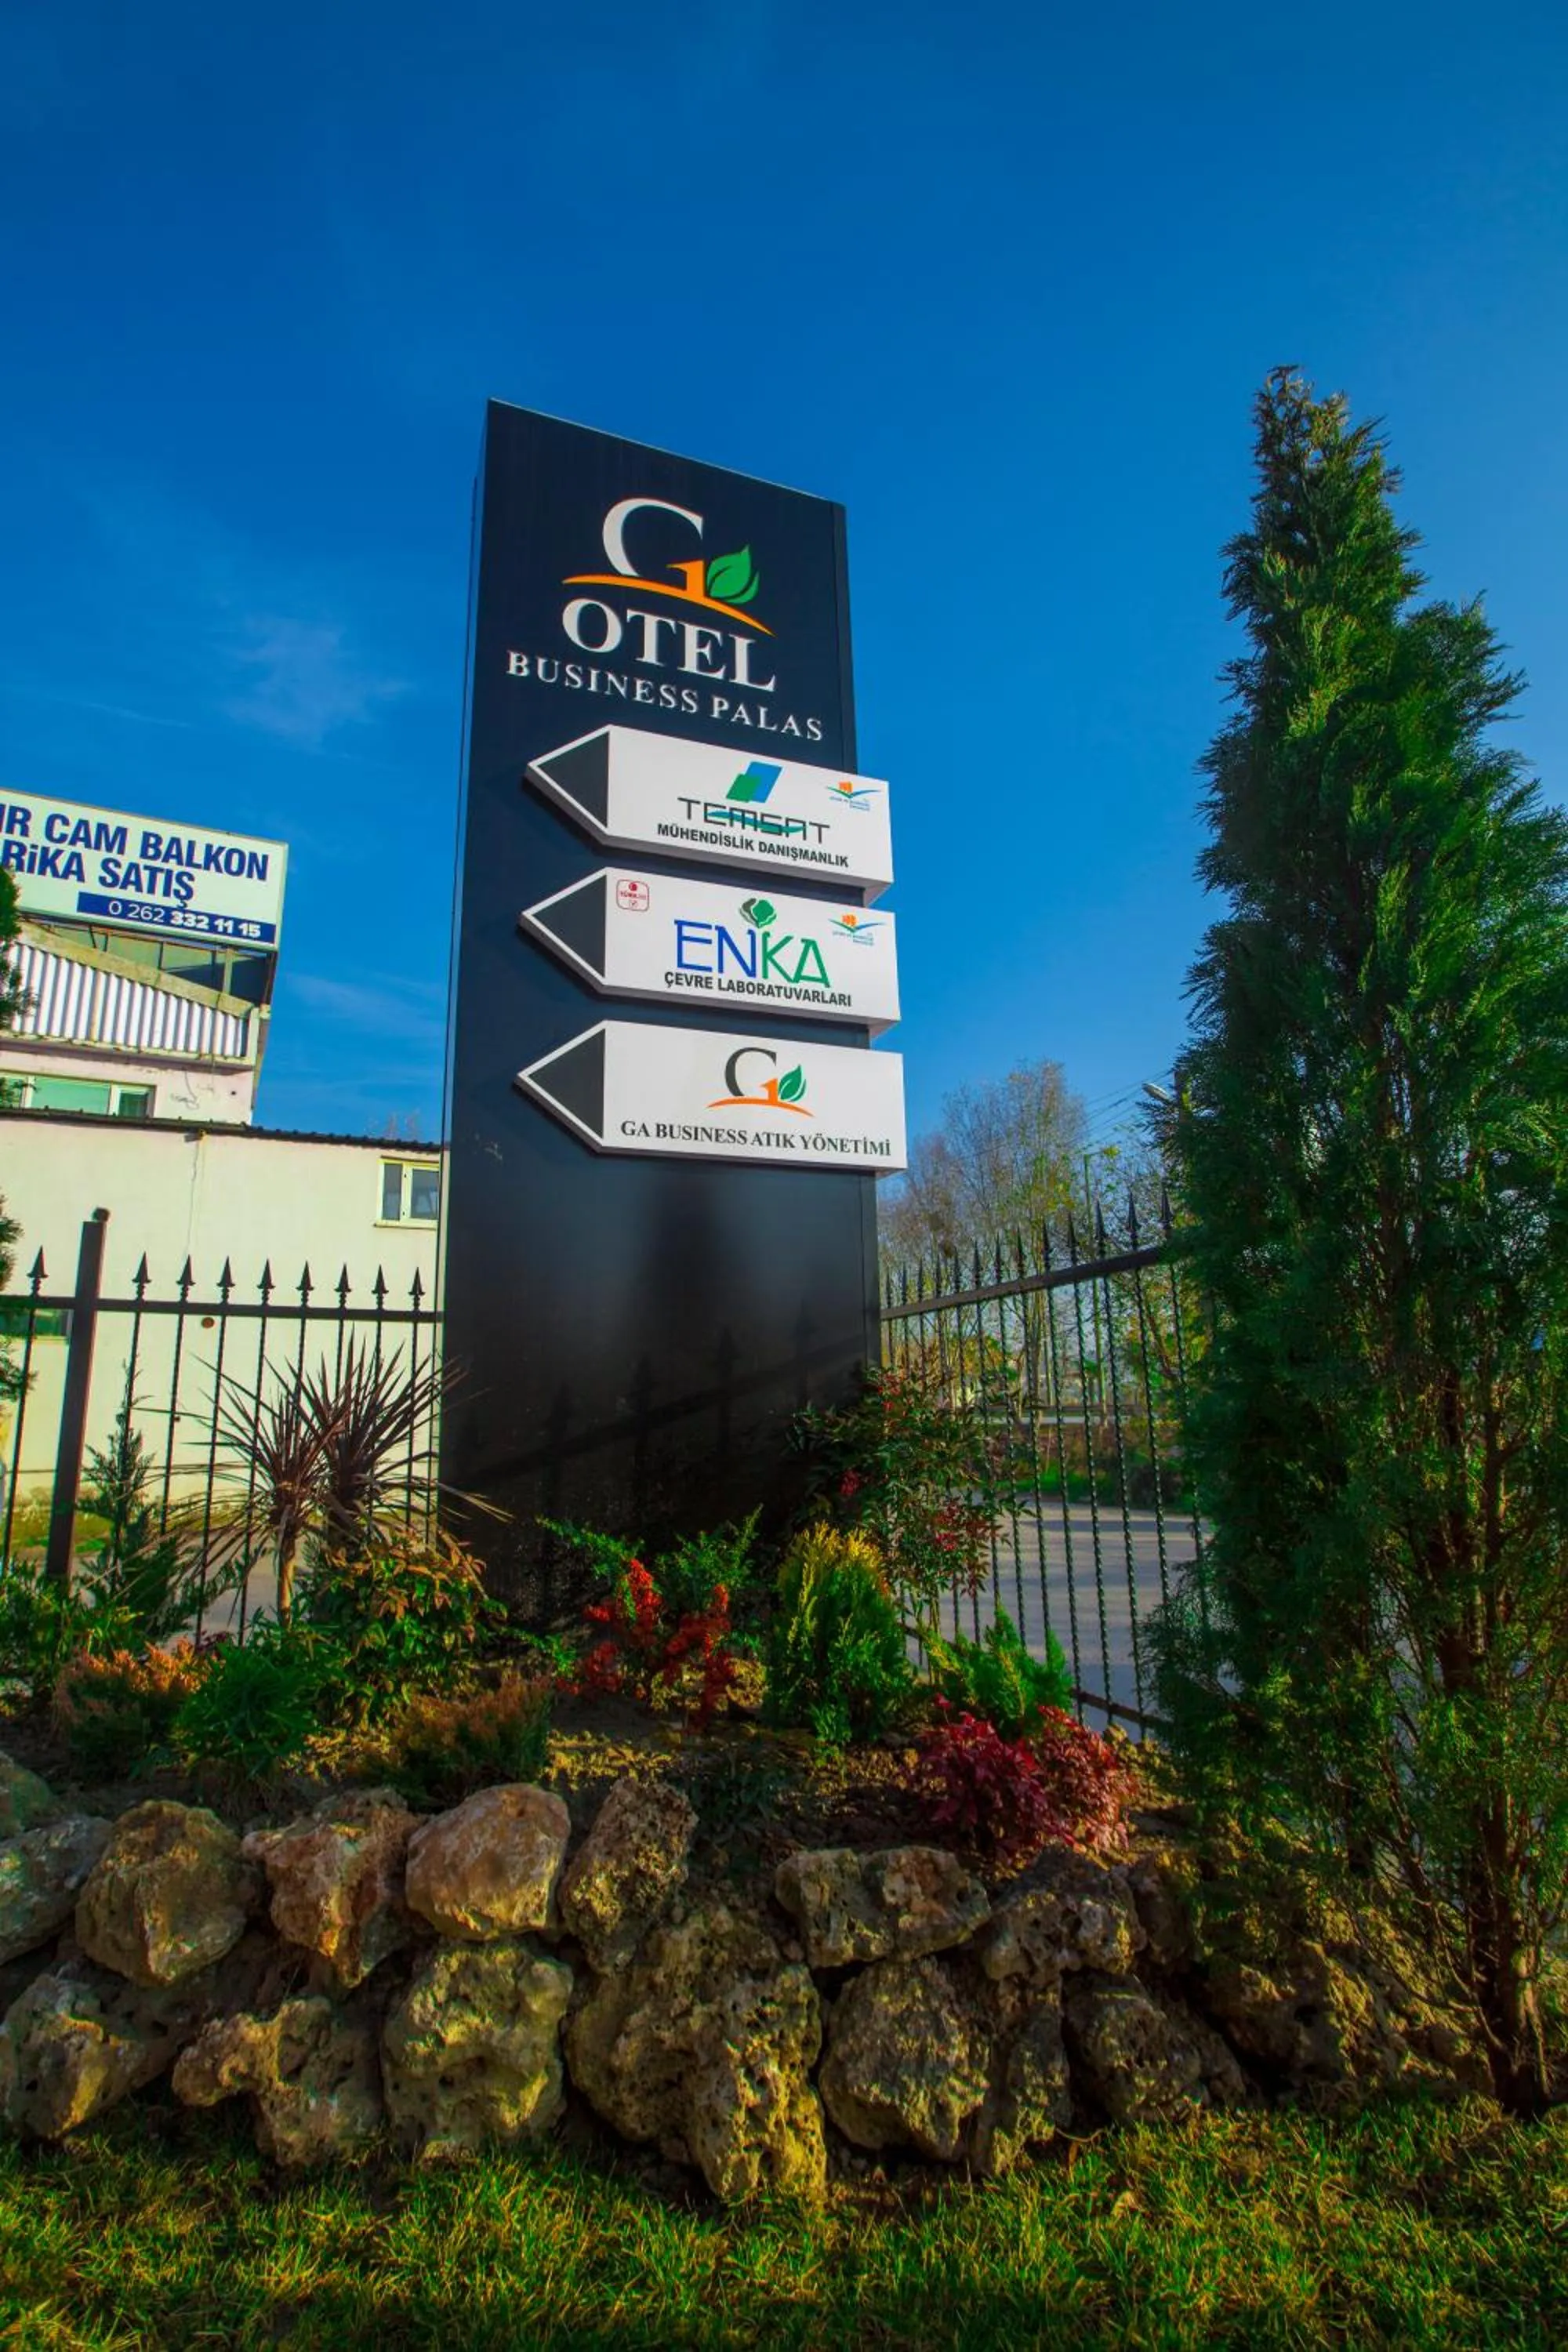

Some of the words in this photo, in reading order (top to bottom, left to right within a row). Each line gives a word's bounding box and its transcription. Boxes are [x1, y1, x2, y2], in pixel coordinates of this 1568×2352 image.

[561, 598, 776, 691] OTEL
[506, 652, 699, 713] BUSINESS
[712, 697, 823, 742] PALAS
[677, 797, 829, 844] TEMSAT
[45, 813, 128, 855] CAM
[140, 831, 269, 881] BALKON
[658, 823, 753, 851] MÜHENDİSLİK
[758, 841, 849, 867] DANIŞMANLIK
[99, 858, 195, 908] SATIŞ
[128, 904, 165, 923] 262
[170, 910, 209, 930] 332
[214, 918, 234, 934] 11
[238, 922, 261, 938] 15
[674, 919, 830, 988] ENKA
[665, 971, 713, 989] ÇEVRE
[718, 978, 851, 1007] LABORATUVARLARI
[621, 1120, 650, 1138] GA
[655, 1123, 747, 1145] BUSINESS
[752, 1132, 796, 1149] ATIK
[800, 1132, 891, 1156] YÖNETİMİ
